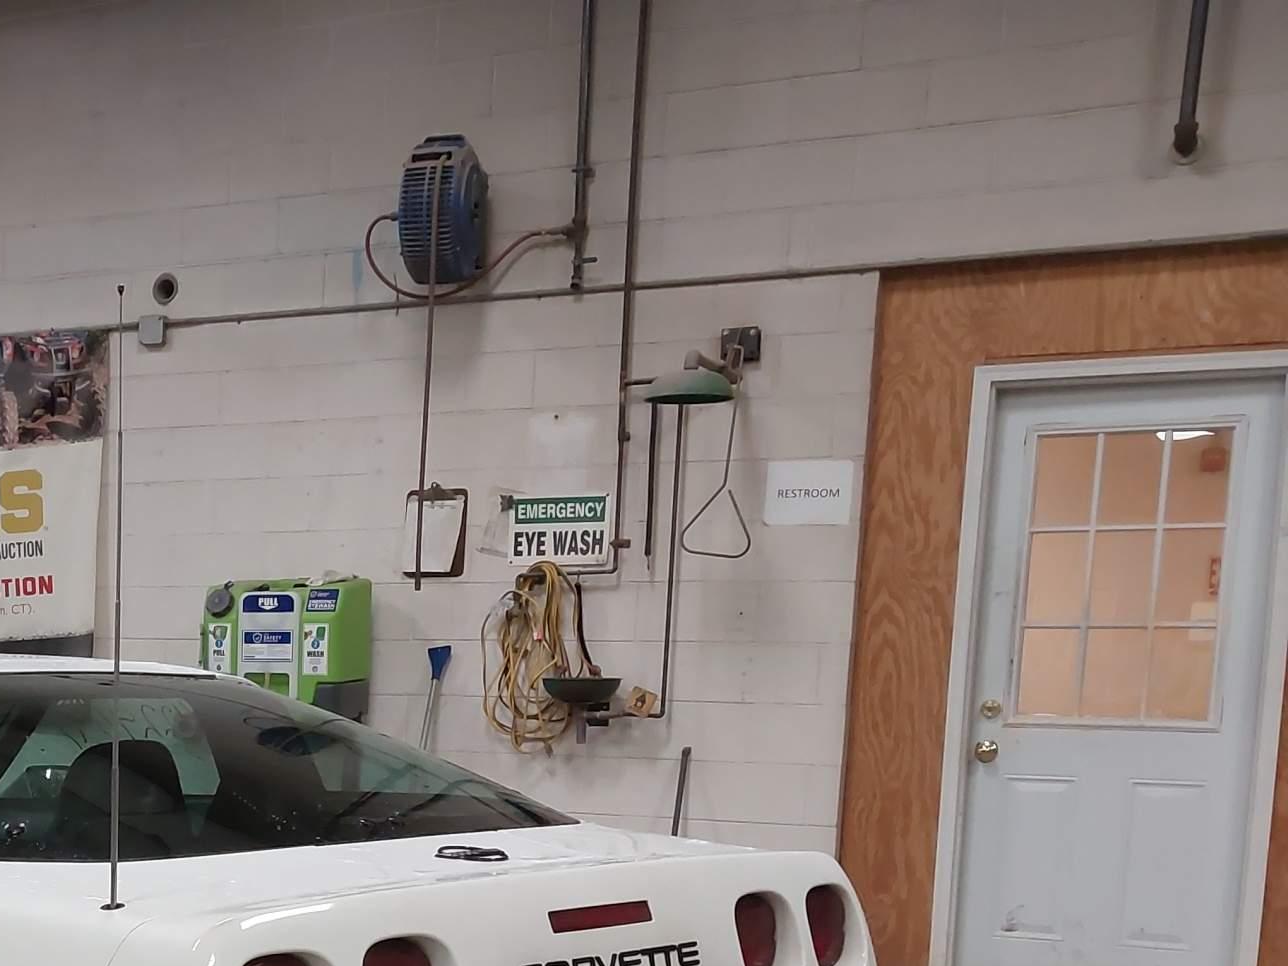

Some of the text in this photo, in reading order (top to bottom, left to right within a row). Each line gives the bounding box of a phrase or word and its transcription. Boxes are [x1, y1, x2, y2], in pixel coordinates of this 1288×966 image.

[777, 488, 841, 499] RESTROOM
[517, 502, 605, 520] EMERGENCY
[513, 529, 604, 557] EYE WASH
[258, 597, 278, 606] PULL
